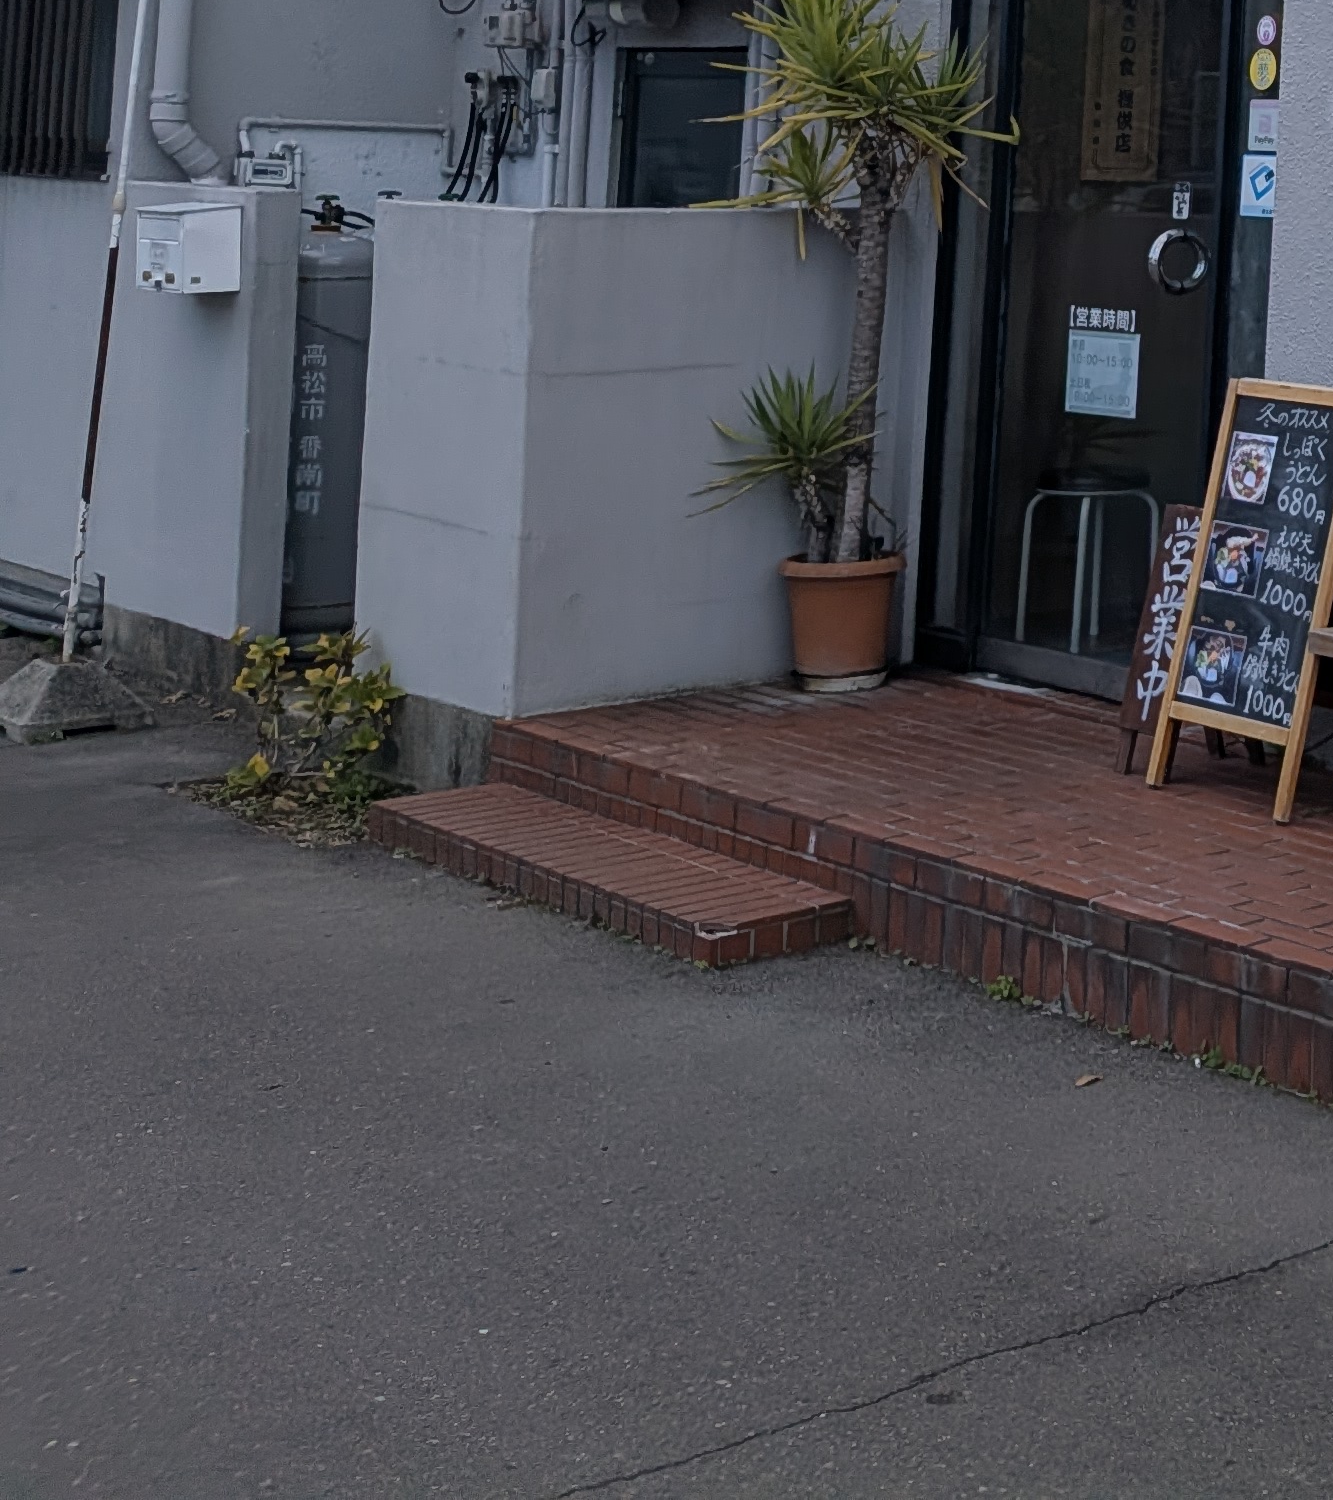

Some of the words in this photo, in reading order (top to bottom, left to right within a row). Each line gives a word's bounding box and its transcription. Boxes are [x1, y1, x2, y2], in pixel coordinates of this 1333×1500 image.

[300, 343, 328, 421] 高松市
[1283, 432, 1328, 461] しっぽく
[1277, 485, 1326, 525] 680円
[1277, 525, 1315, 555] えび天
[1136, 515, 1201, 722] 営業中
[1257, 625, 1290, 665] 牛肉
